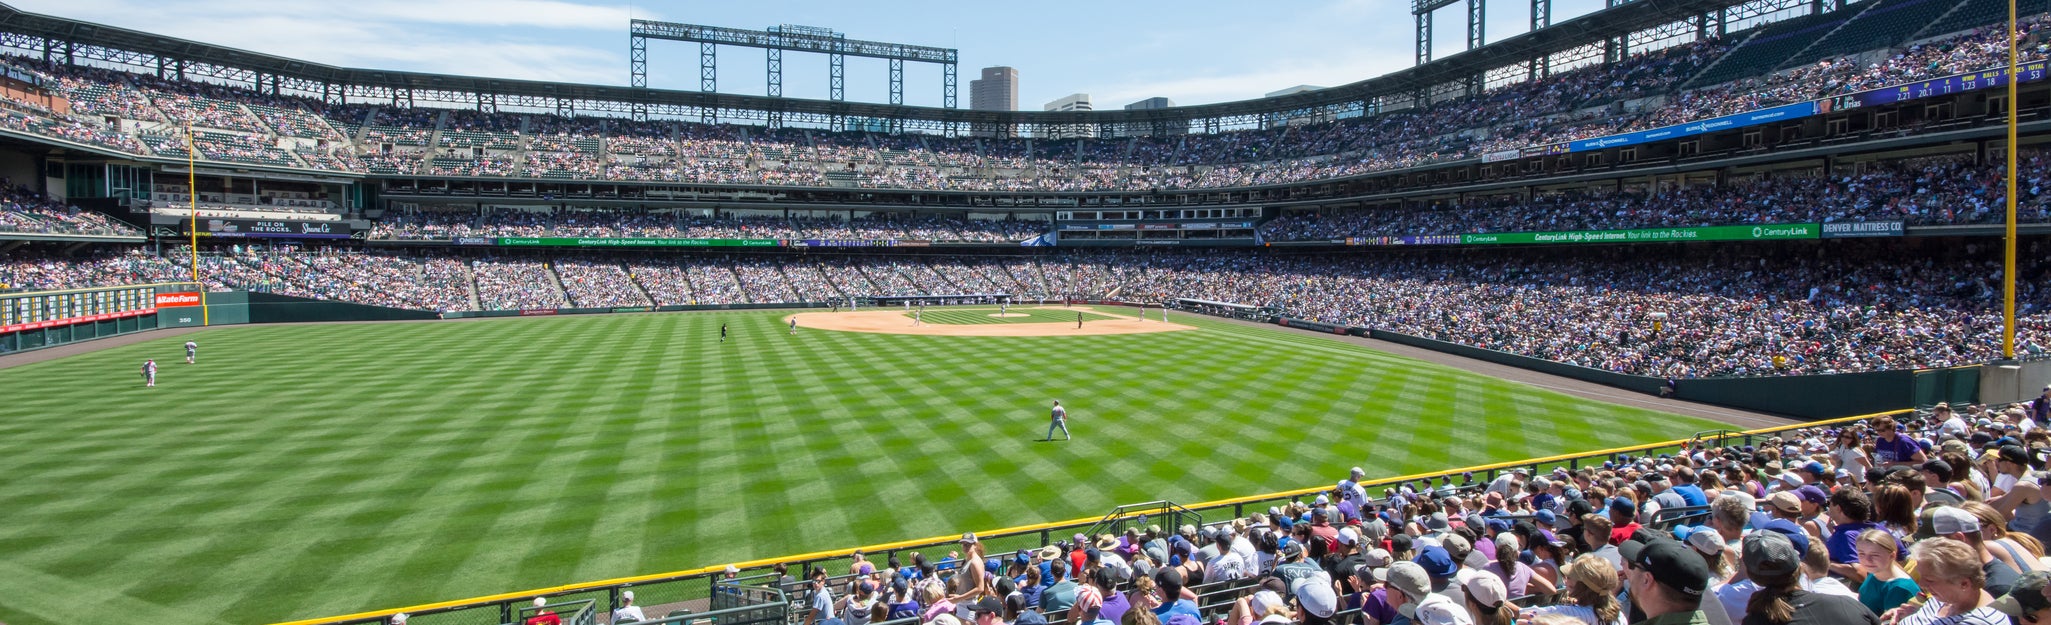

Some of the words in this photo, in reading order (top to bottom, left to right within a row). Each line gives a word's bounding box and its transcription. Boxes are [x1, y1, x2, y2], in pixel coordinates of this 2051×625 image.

[1982, 71, 1999, 79] BALLS
[2004, 66, 2025, 75] STKES
[2028, 63, 2045, 71] TOTAL
[1897, 92, 1911, 101] 2.21
[1918, 88, 1933, 98] 20.1
[1943, 85, 1951, 94] 11
[1962, 81, 1976, 91] 1.23
[1987, 77, 1996, 87] 18
[2030, 70, 2040, 80] 53
[1763, 227, 1808, 237] CenturyLink
[1823, 223, 1851, 233] DENVER
[1853, 222, 1889, 232] MATTRESS
[1890, 222, 1903, 231] CO.
[1535, 232, 1567, 242] CenturyLink
[1568, 231, 1604, 242] High-Speed
[1627, 231, 1640, 239] Your
[1640, 230, 1652, 238] link
[1652, 230, 1659, 238] to
[1659, 229, 1670, 237] the
